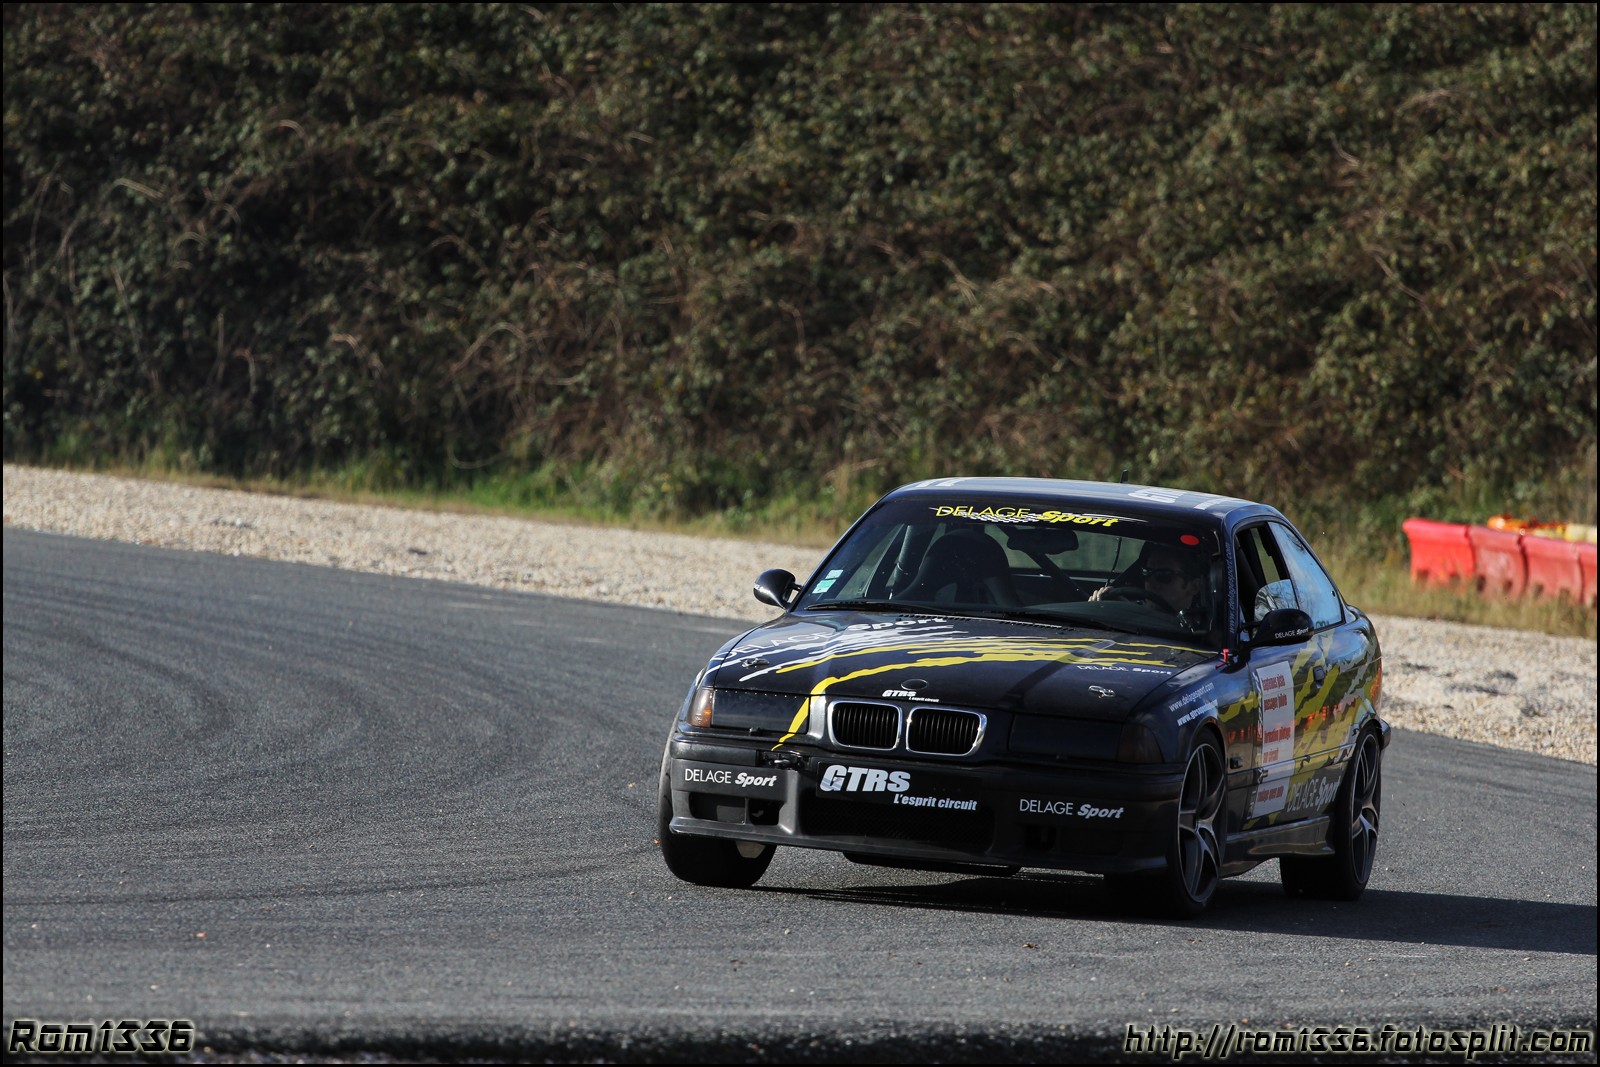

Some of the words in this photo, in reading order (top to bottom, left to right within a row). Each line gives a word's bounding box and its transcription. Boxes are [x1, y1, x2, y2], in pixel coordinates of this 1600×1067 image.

[935, 505, 1031, 518] DELAGE
[1037, 510, 1119, 527] Sport
[1275, 630, 1295, 639] DELAGE
[1296, 627, 1309, 636] Sport
[1132, 667, 1172, 675] Sport
[882, 689, 917, 697] GTRS
[684, 768, 732, 784] DELAGE
[735, 772, 777, 788] Sport
[819, 764, 911, 793] GTRS
[893, 793, 937, 808] L'esprit
[937, 798, 977, 811] circuit
[1286, 778, 1319, 812] DELAGE
[1315, 776, 1341, 811] Sport
[1019, 799, 1073, 815] DELAGE
[1077, 804, 1125, 820] Sport
